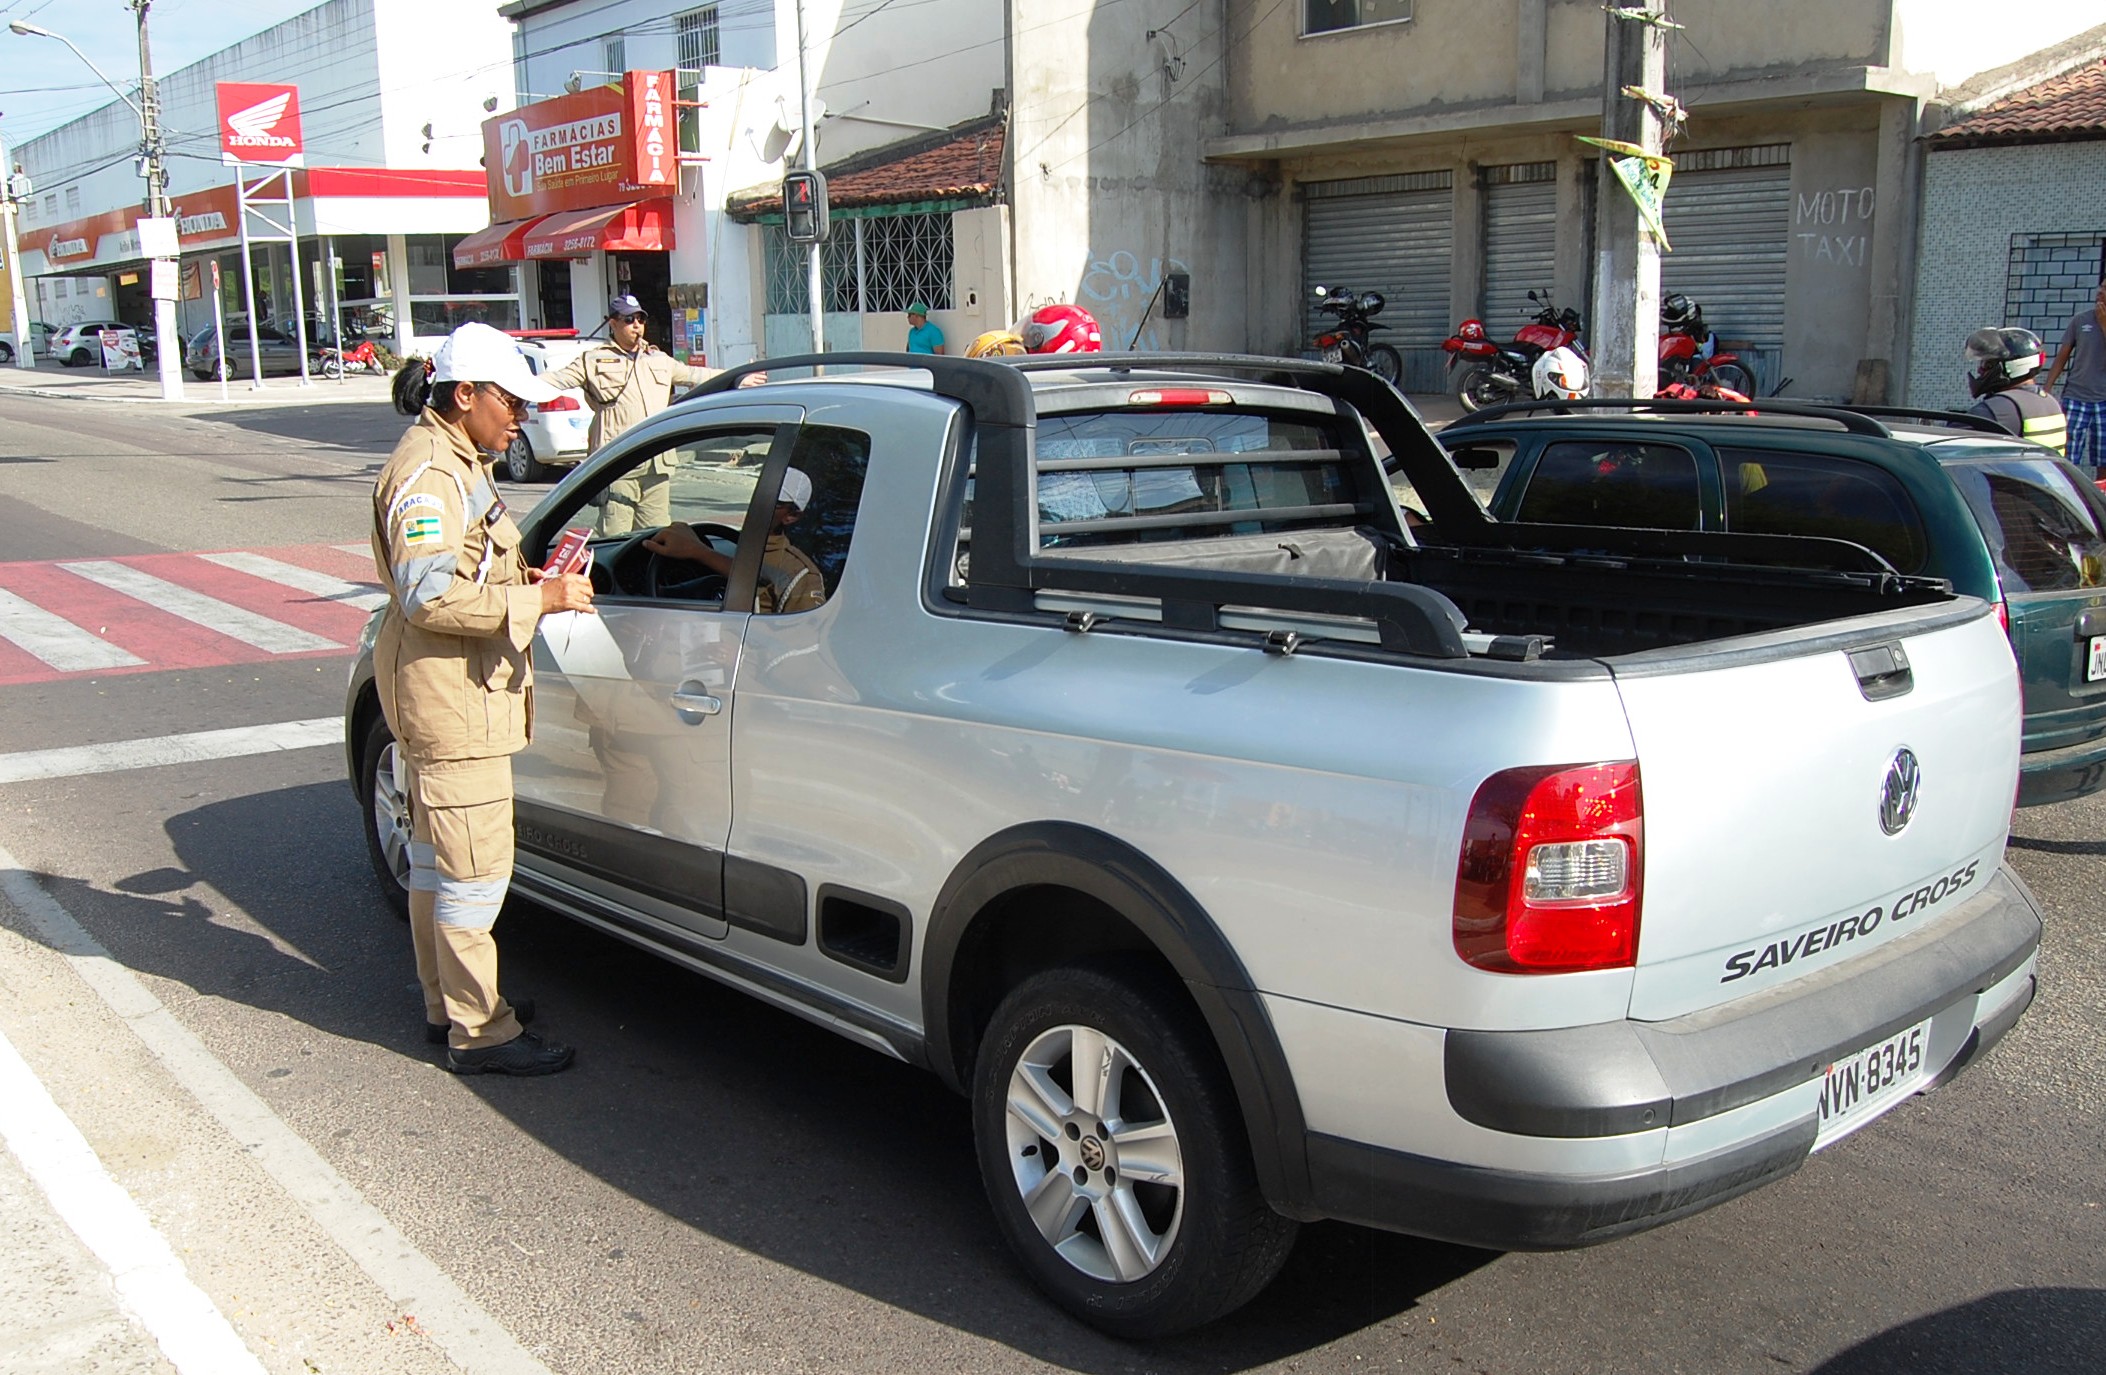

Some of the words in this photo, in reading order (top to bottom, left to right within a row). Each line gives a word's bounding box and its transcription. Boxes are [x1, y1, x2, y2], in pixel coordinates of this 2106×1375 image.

[229, 135, 296, 147] HONDA
[534, 119, 615, 149] FARMÁCIAS
[645, 75, 665, 182] FARMÁCIA
[535, 153, 567, 176] Bem
[571, 144, 615, 169] Estar
[1796, 187, 1875, 225] MOTO
[180, 212, 227, 235] HONDA
[1797, 233, 1866, 267] TAXI
[398, 496, 444, 515] ARACAJU
[2091, 652, 2106, 676] JN
[1720, 906, 1883, 983] SAVEIRO
[1890, 859, 1980, 922] CROSS
